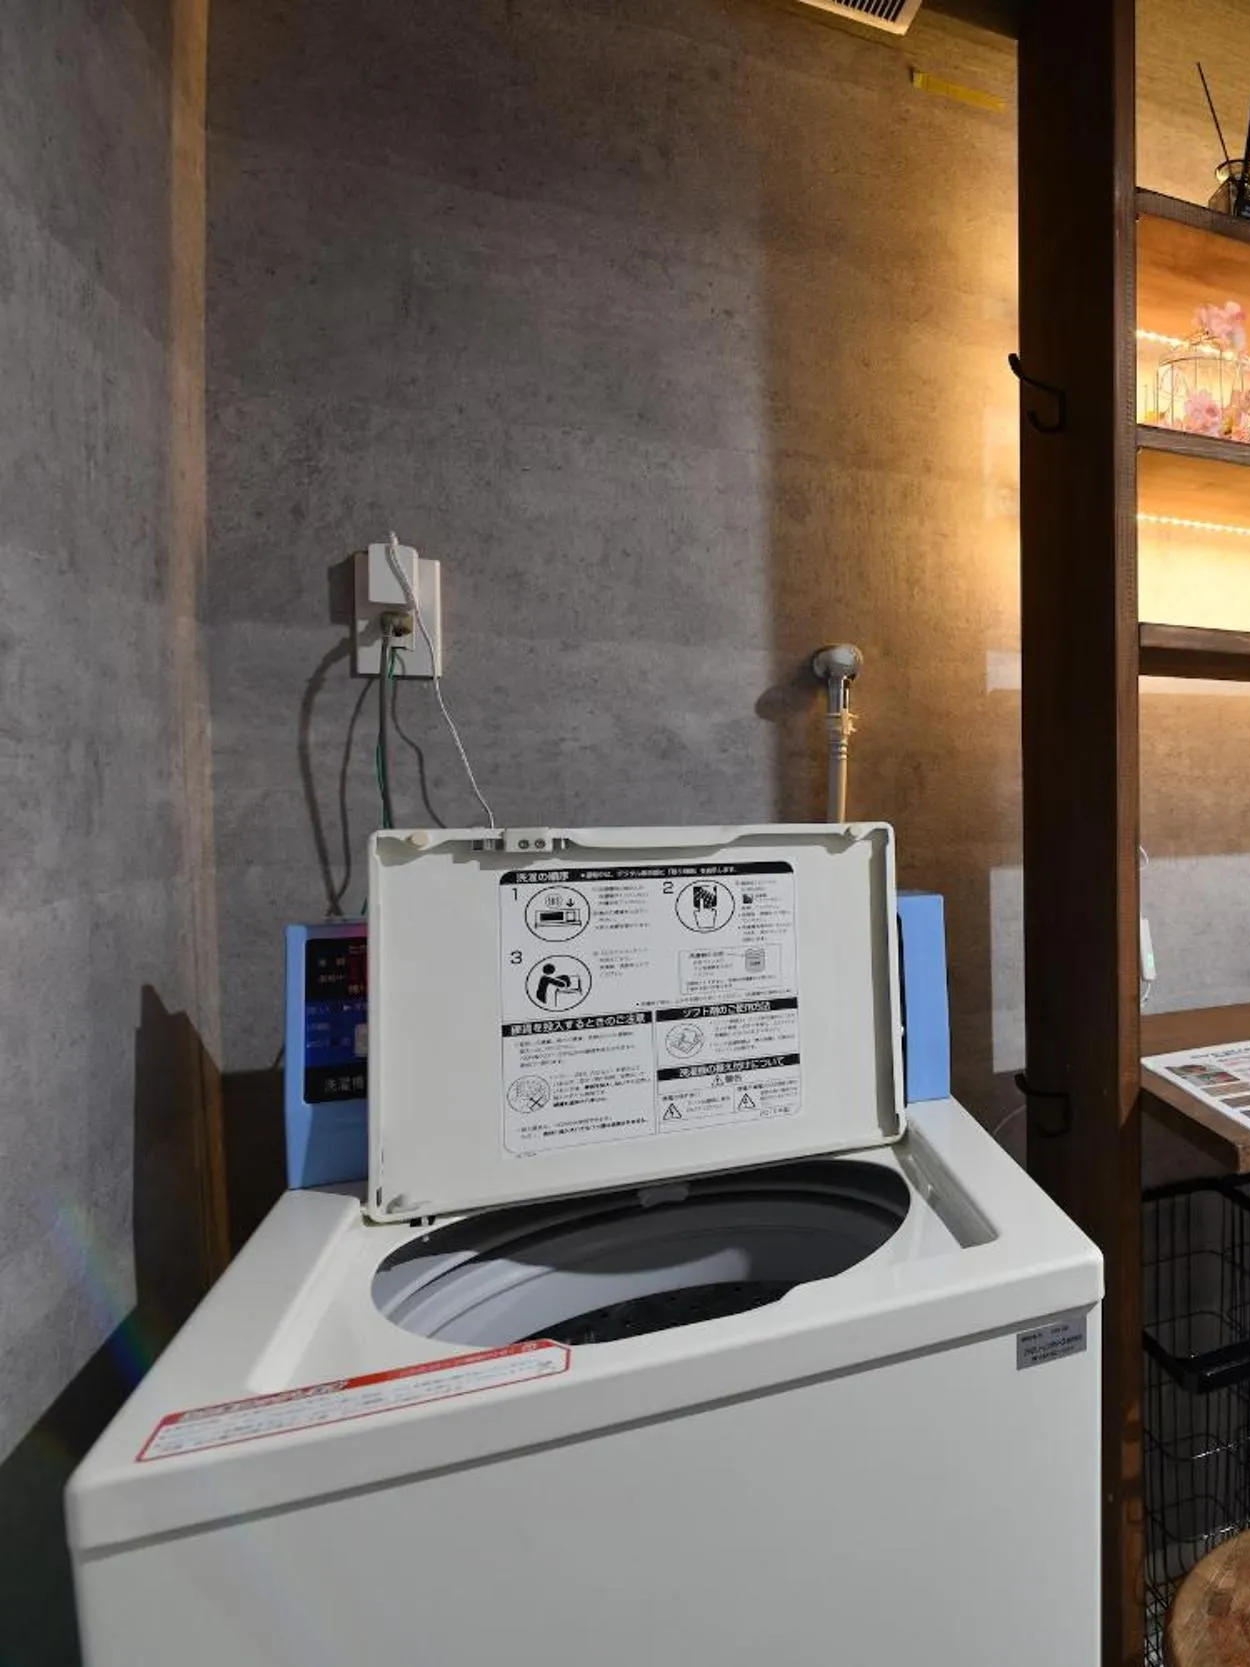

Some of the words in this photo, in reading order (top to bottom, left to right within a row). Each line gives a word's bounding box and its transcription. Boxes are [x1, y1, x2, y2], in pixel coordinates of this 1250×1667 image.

[663, 881, 675, 894] 2
[511, 888, 518, 901] 1
[510, 951, 523, 965] 3
